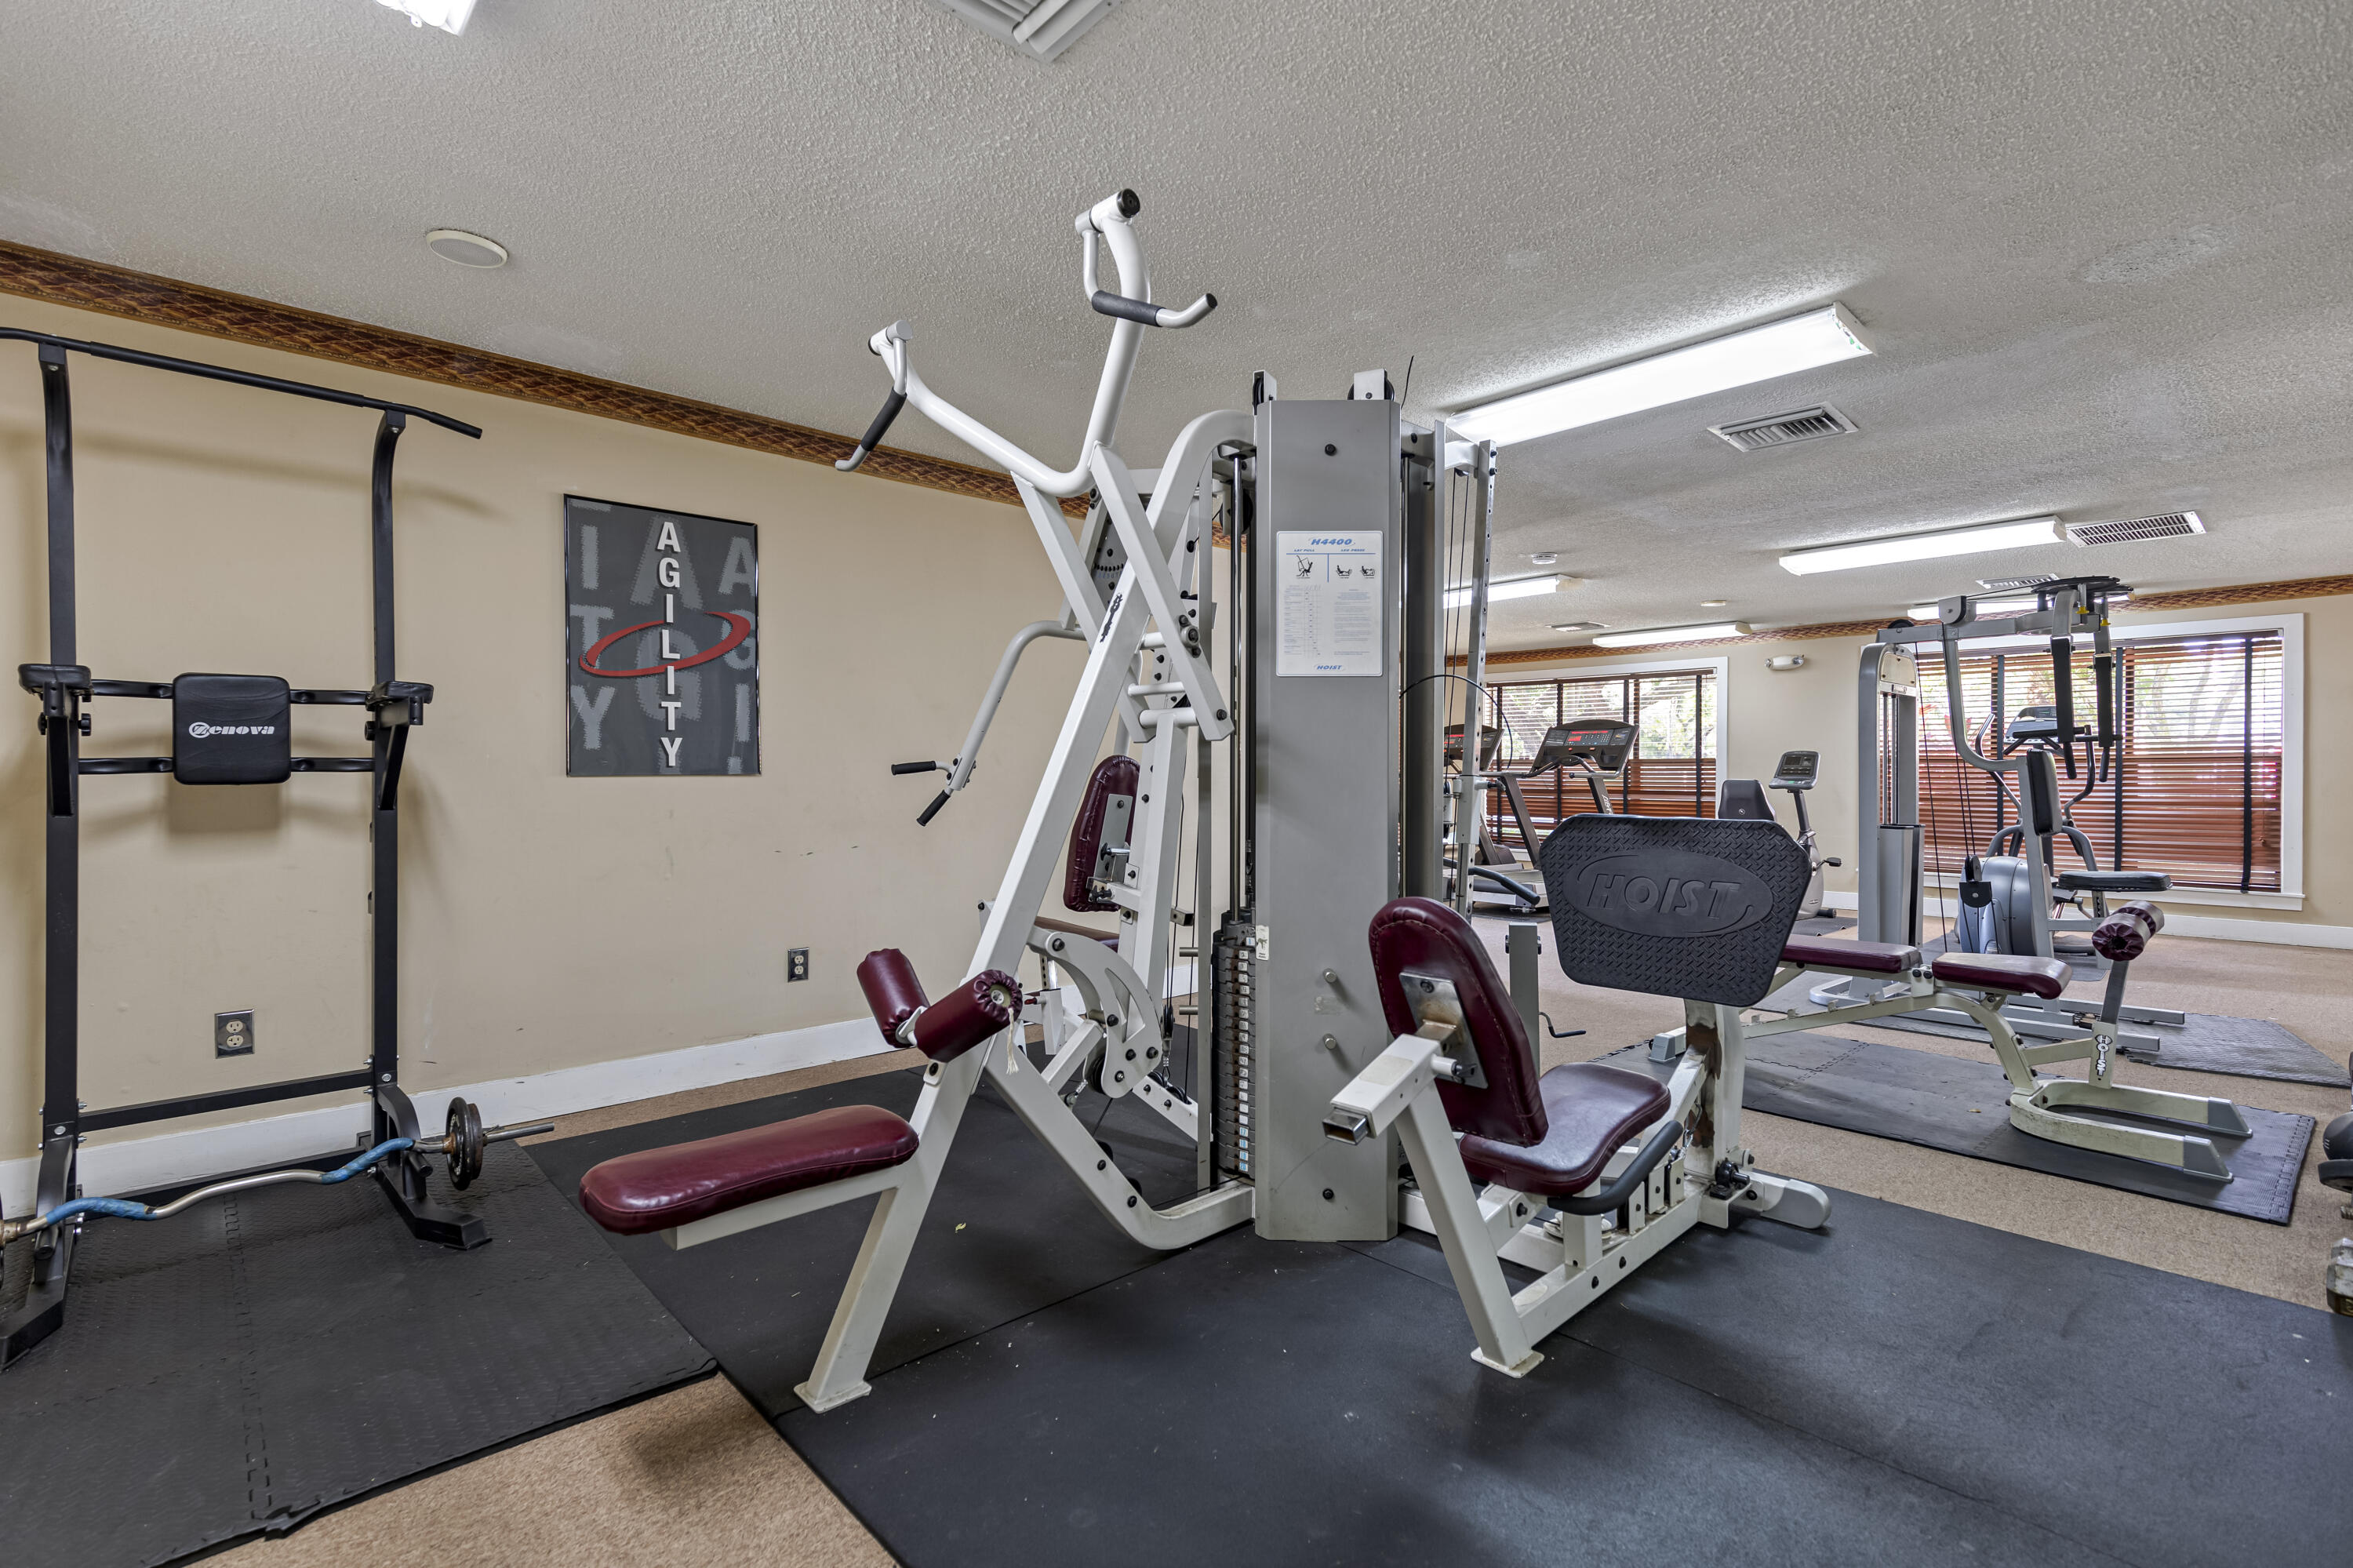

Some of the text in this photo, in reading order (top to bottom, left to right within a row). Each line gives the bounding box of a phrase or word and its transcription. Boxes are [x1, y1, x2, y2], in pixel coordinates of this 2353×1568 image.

[657, 522, 683, 766] AGILITY
[1587, 872, 1740, 919] HOIST
[2095, 1035, 2112, 1076] HOIST
